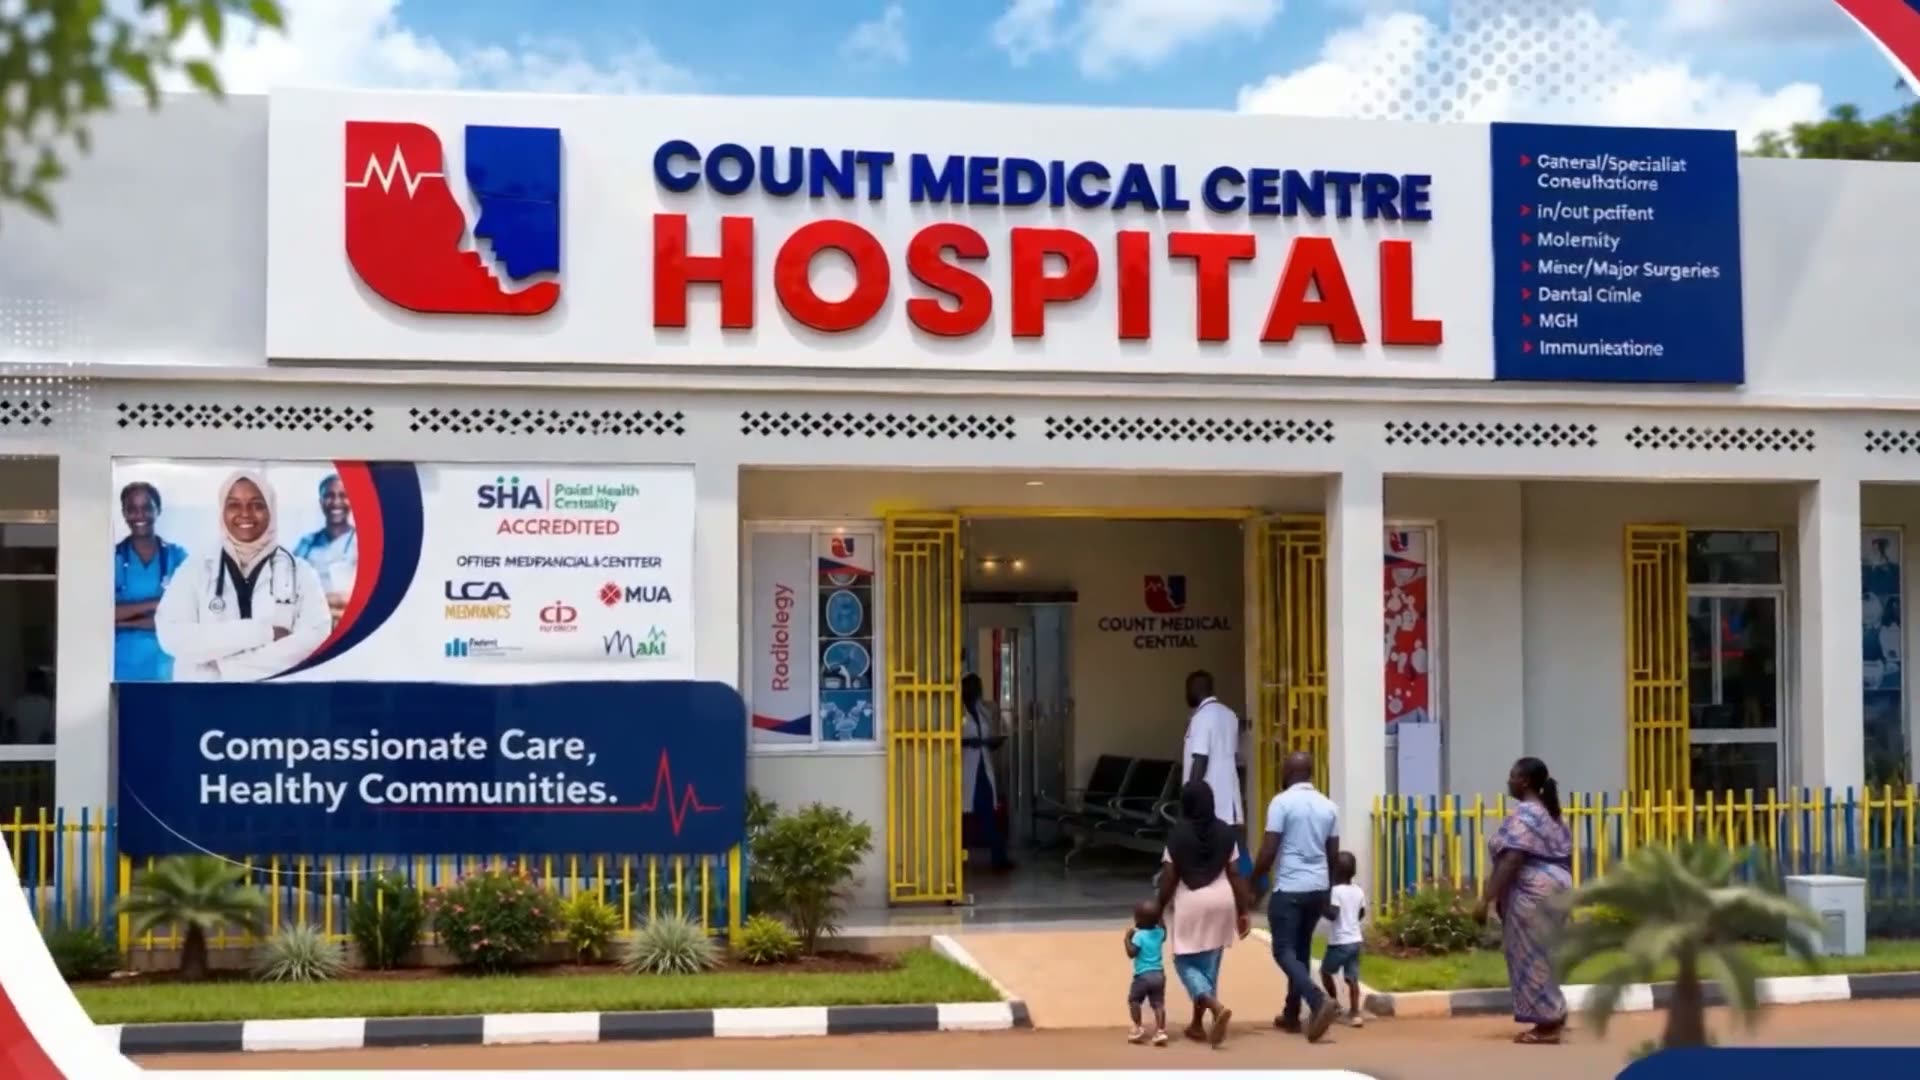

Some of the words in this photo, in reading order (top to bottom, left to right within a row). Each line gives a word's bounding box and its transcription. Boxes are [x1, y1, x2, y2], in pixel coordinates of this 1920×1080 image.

[653, 139, 894, 200] COUNT
[910, 153, 1190, 212] MEDICAL
[1201, 166, 1432, 221] CENTRE
[653, 213, 1443, 346] HOSPITAL
[1643, 262, 1720, 281] Surgeries
[1539, 313, 1578, 328] MGH
[477, 476, 543, 509] SHA
[497, 519, 620, 536] ACCREDITED
[445, 580, 511, 601] LCA
[625, 586, 673, 604] MUA
[1098, 616, 1157, 632] COUNT
[199, 729, 488, 768] Compassionate
[498, 729, 598, 767] Care,
[199, 773, 349, 813] Healthy
[358, 773, 619, 805] Communities.
